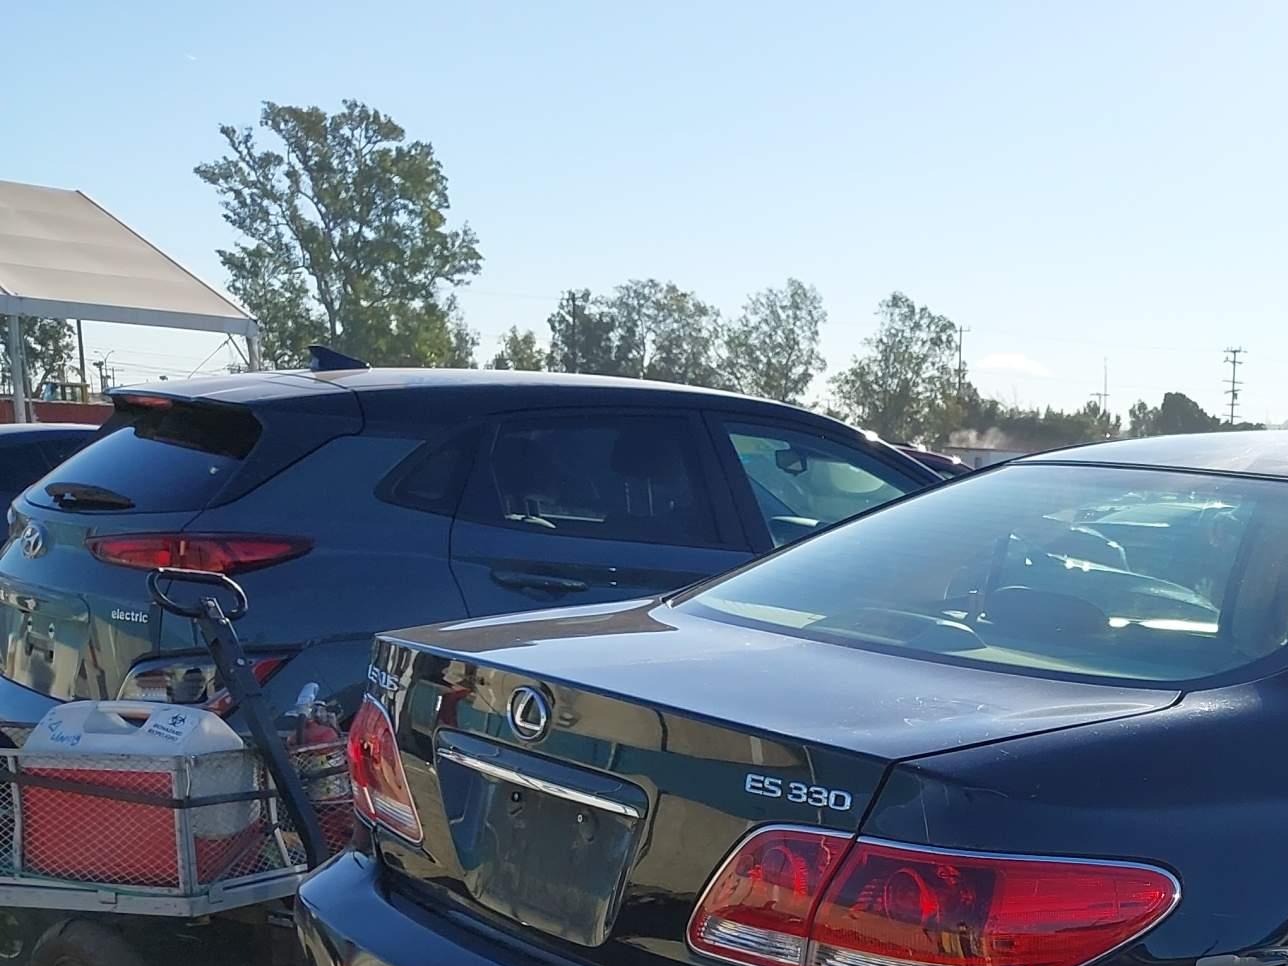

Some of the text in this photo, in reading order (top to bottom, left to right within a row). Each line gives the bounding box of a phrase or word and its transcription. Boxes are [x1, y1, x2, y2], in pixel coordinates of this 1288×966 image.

[111, 608, 149, 624] electric
[367, 663, 399, 691] LEXUS
[745, 773, 852, 811] ES 330
